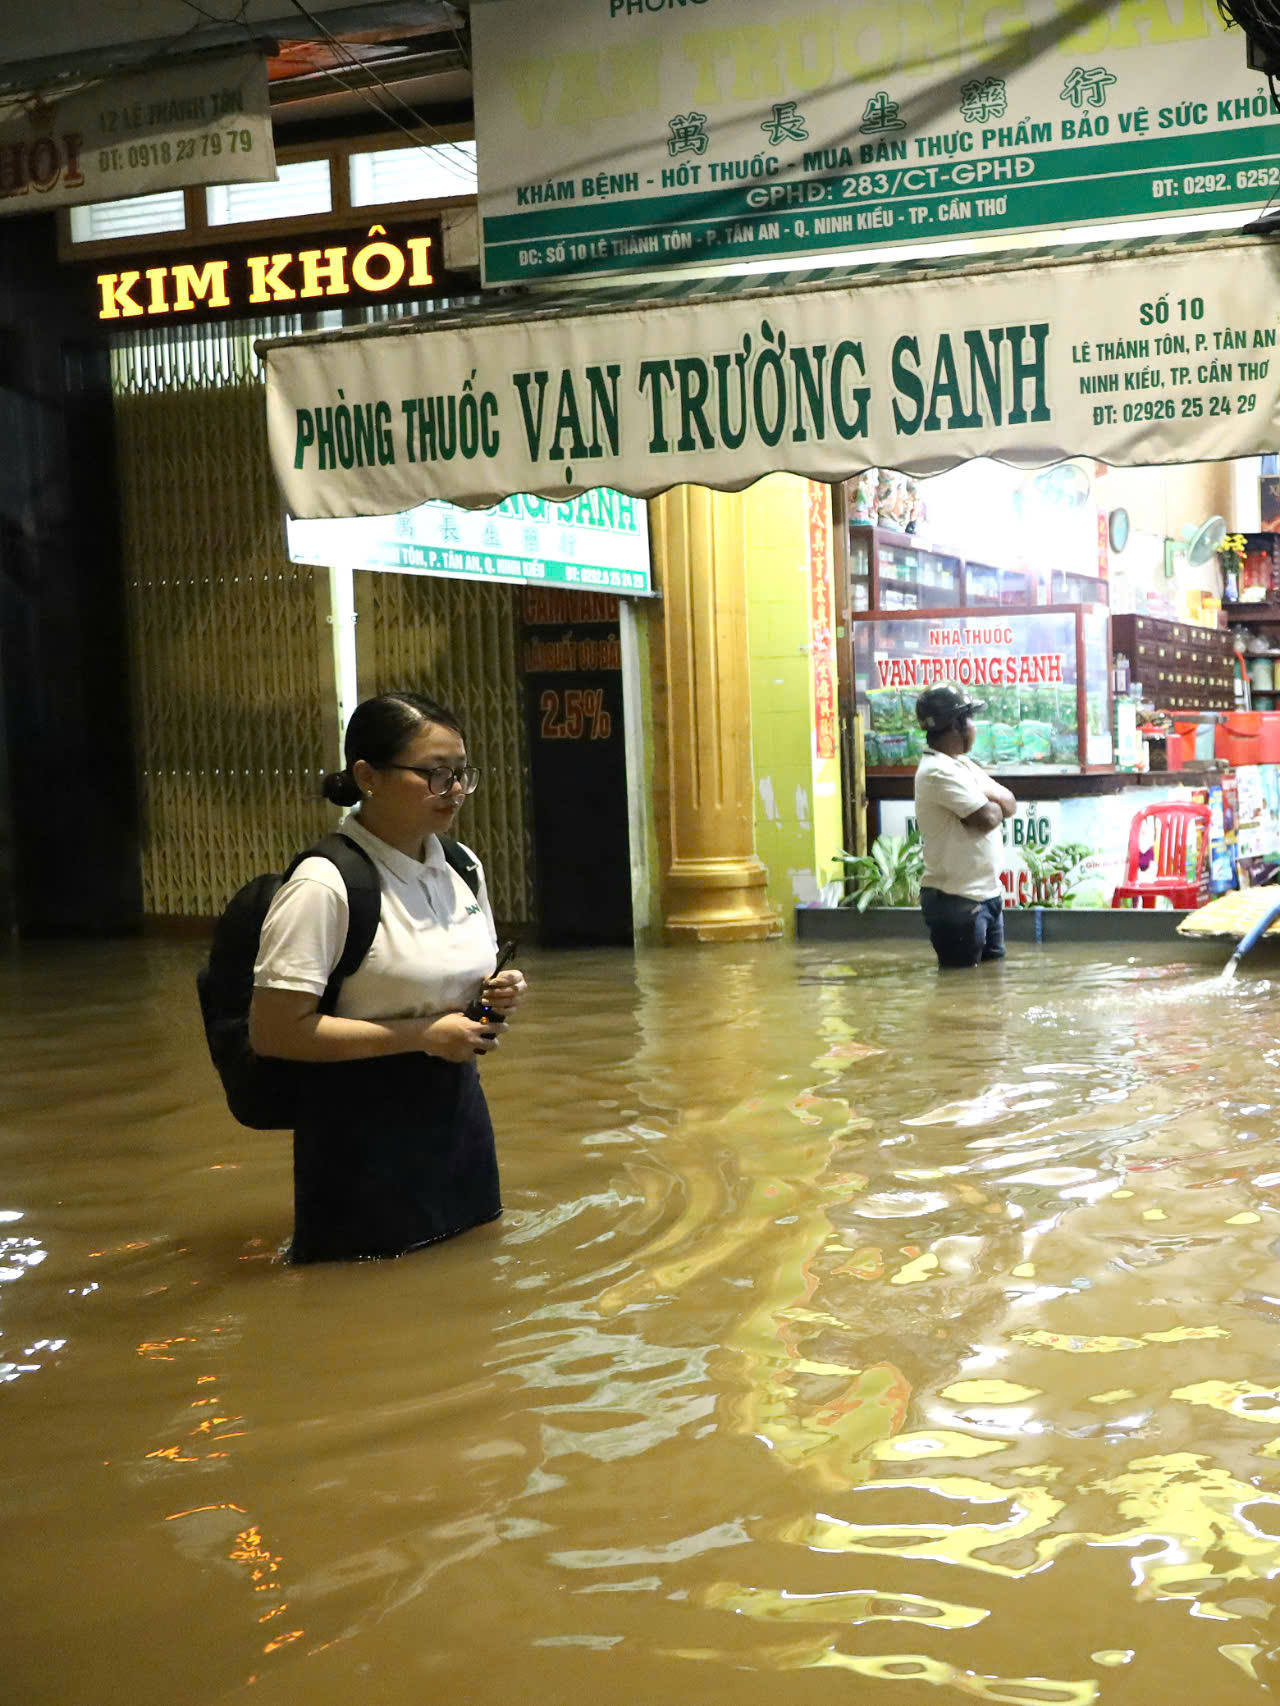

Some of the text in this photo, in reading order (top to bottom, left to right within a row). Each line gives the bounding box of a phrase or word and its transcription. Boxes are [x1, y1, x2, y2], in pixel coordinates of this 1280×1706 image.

[128, 140, 172, 169] 0918
[176, 138, 196, 162] 23
[201, 132, 222, 157] 79
[226, 129, 253, 153] 79
[517, 178, 575, 206] KHÁM
[582, 171, 639, 200] BỆNH
[661, 160, 701, 188] HỐT
[708, 151, 779, 182] THUỐC
[803, 148, 853, 173] MUA
[860, 139, 908, 165] BÁN
[915, 129, 974, 159] THỰC
[982, 116, 1052, 151] PHẨM
[1062, 108, 1110, 141] BẢO
[1118, 104, 1150, 137] VỆ
[1158, 100, 1209, 129] SỨC
[746, 156, 1036, 209] GPHĐ: 283/CT-GPHĐ
[519, 248, 543, 267] ĐC:
[546, 240, 566, 263] SỐ
[570, 242, 587, 261] 10
[590, 238, 609, 259] LÊ
[611, 233, 660, 257] THÁNH
[662, 229, 693, 251] TÔN
[727, 222, 755, 245] TÂN
[758, 222, 780, 241] AN
[793, 219, 810, 239] Q.
[814, 215, 853, 235] NINH
[857, 205, 894, 231] KIỀU
[908, 206, 934, 225] TP.
[938, 196, 973, 221] CẦN
[976, 193, 1009, 217] THƠ
[1152, 176, 1179, 198] ĐT:
[1184, 172, 1232, 196] 0292.
[97, 225, 434, 320] KIM KHÔI
[1139, 293, 1205, 326] SỐ 10
[1072, 327, 1277, 363] LÊ THÁNH TÔN, P. TÂN AN
[1079, 358, 1270, 395] NINH KIỀU, TP. CẦN THƠ
[294, 319, 1052, 485] PHÒNG THUỐC VẠN TRƯỜNG SANH
[1093, 393, 1257, 426] ĐT: 02926 25 24 29
[1006, 655, 1063, 683] SANH
[540, 688, 612, 740] 2.5%
[1013, 800, 1050, 845] BẮC
